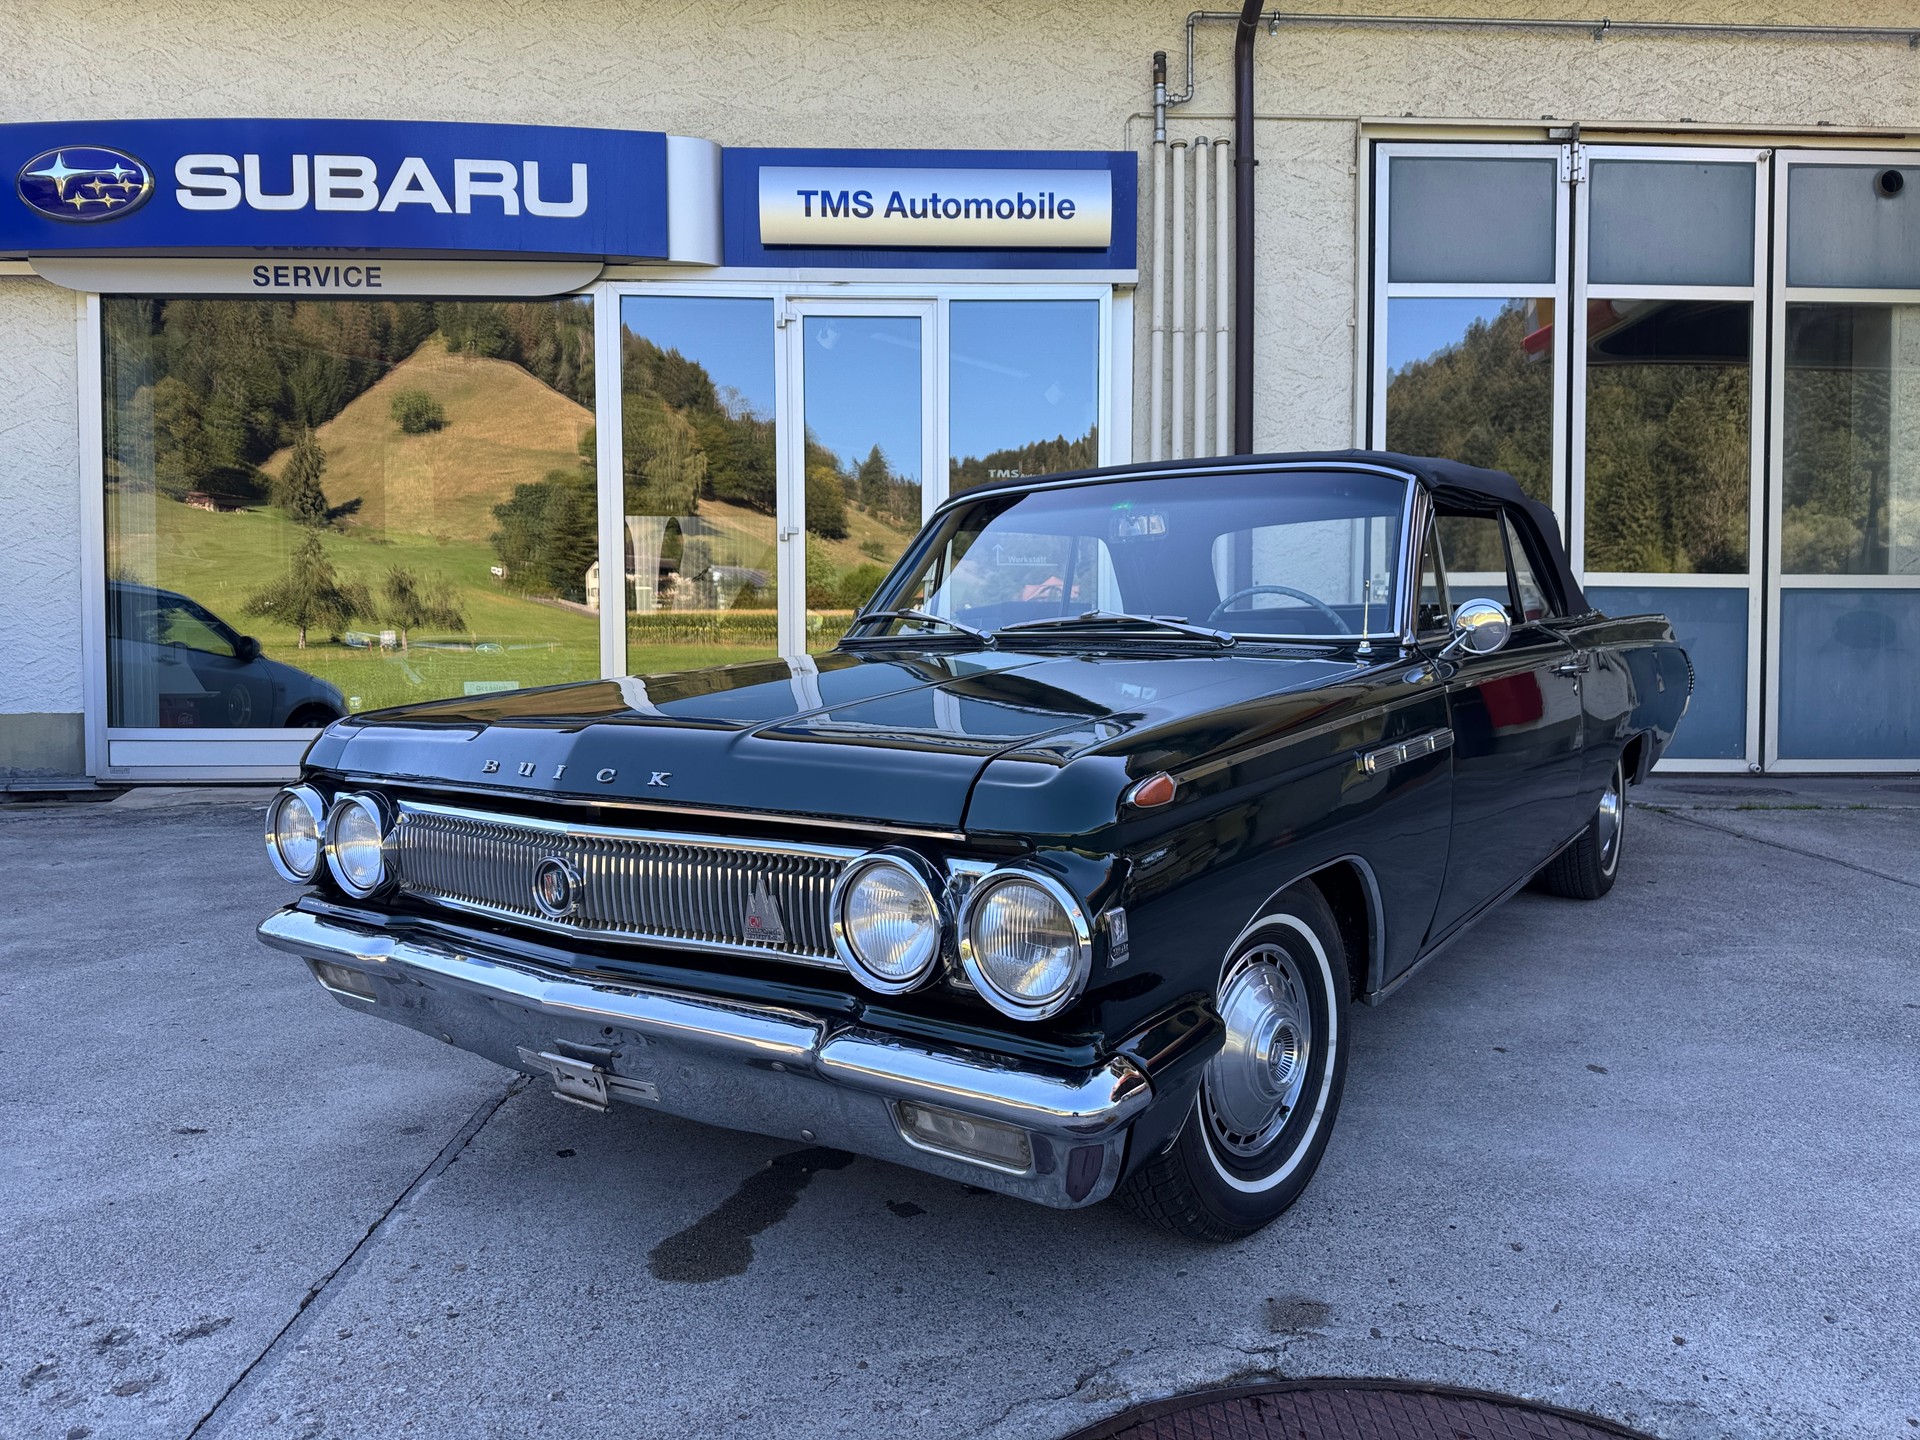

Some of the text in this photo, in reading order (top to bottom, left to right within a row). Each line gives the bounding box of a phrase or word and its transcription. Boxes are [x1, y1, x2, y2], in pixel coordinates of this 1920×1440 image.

[174, 153, 588, 218] SUBARU
[796, 189, 1077, 221] TMS Automobile
[252, 264, 382, 288] SERVICE
[987, 469, 1019, 478] TMS
[1007, 555, 1047, 563] Werkstatt
[481, 759, 673, 787] BUICK
